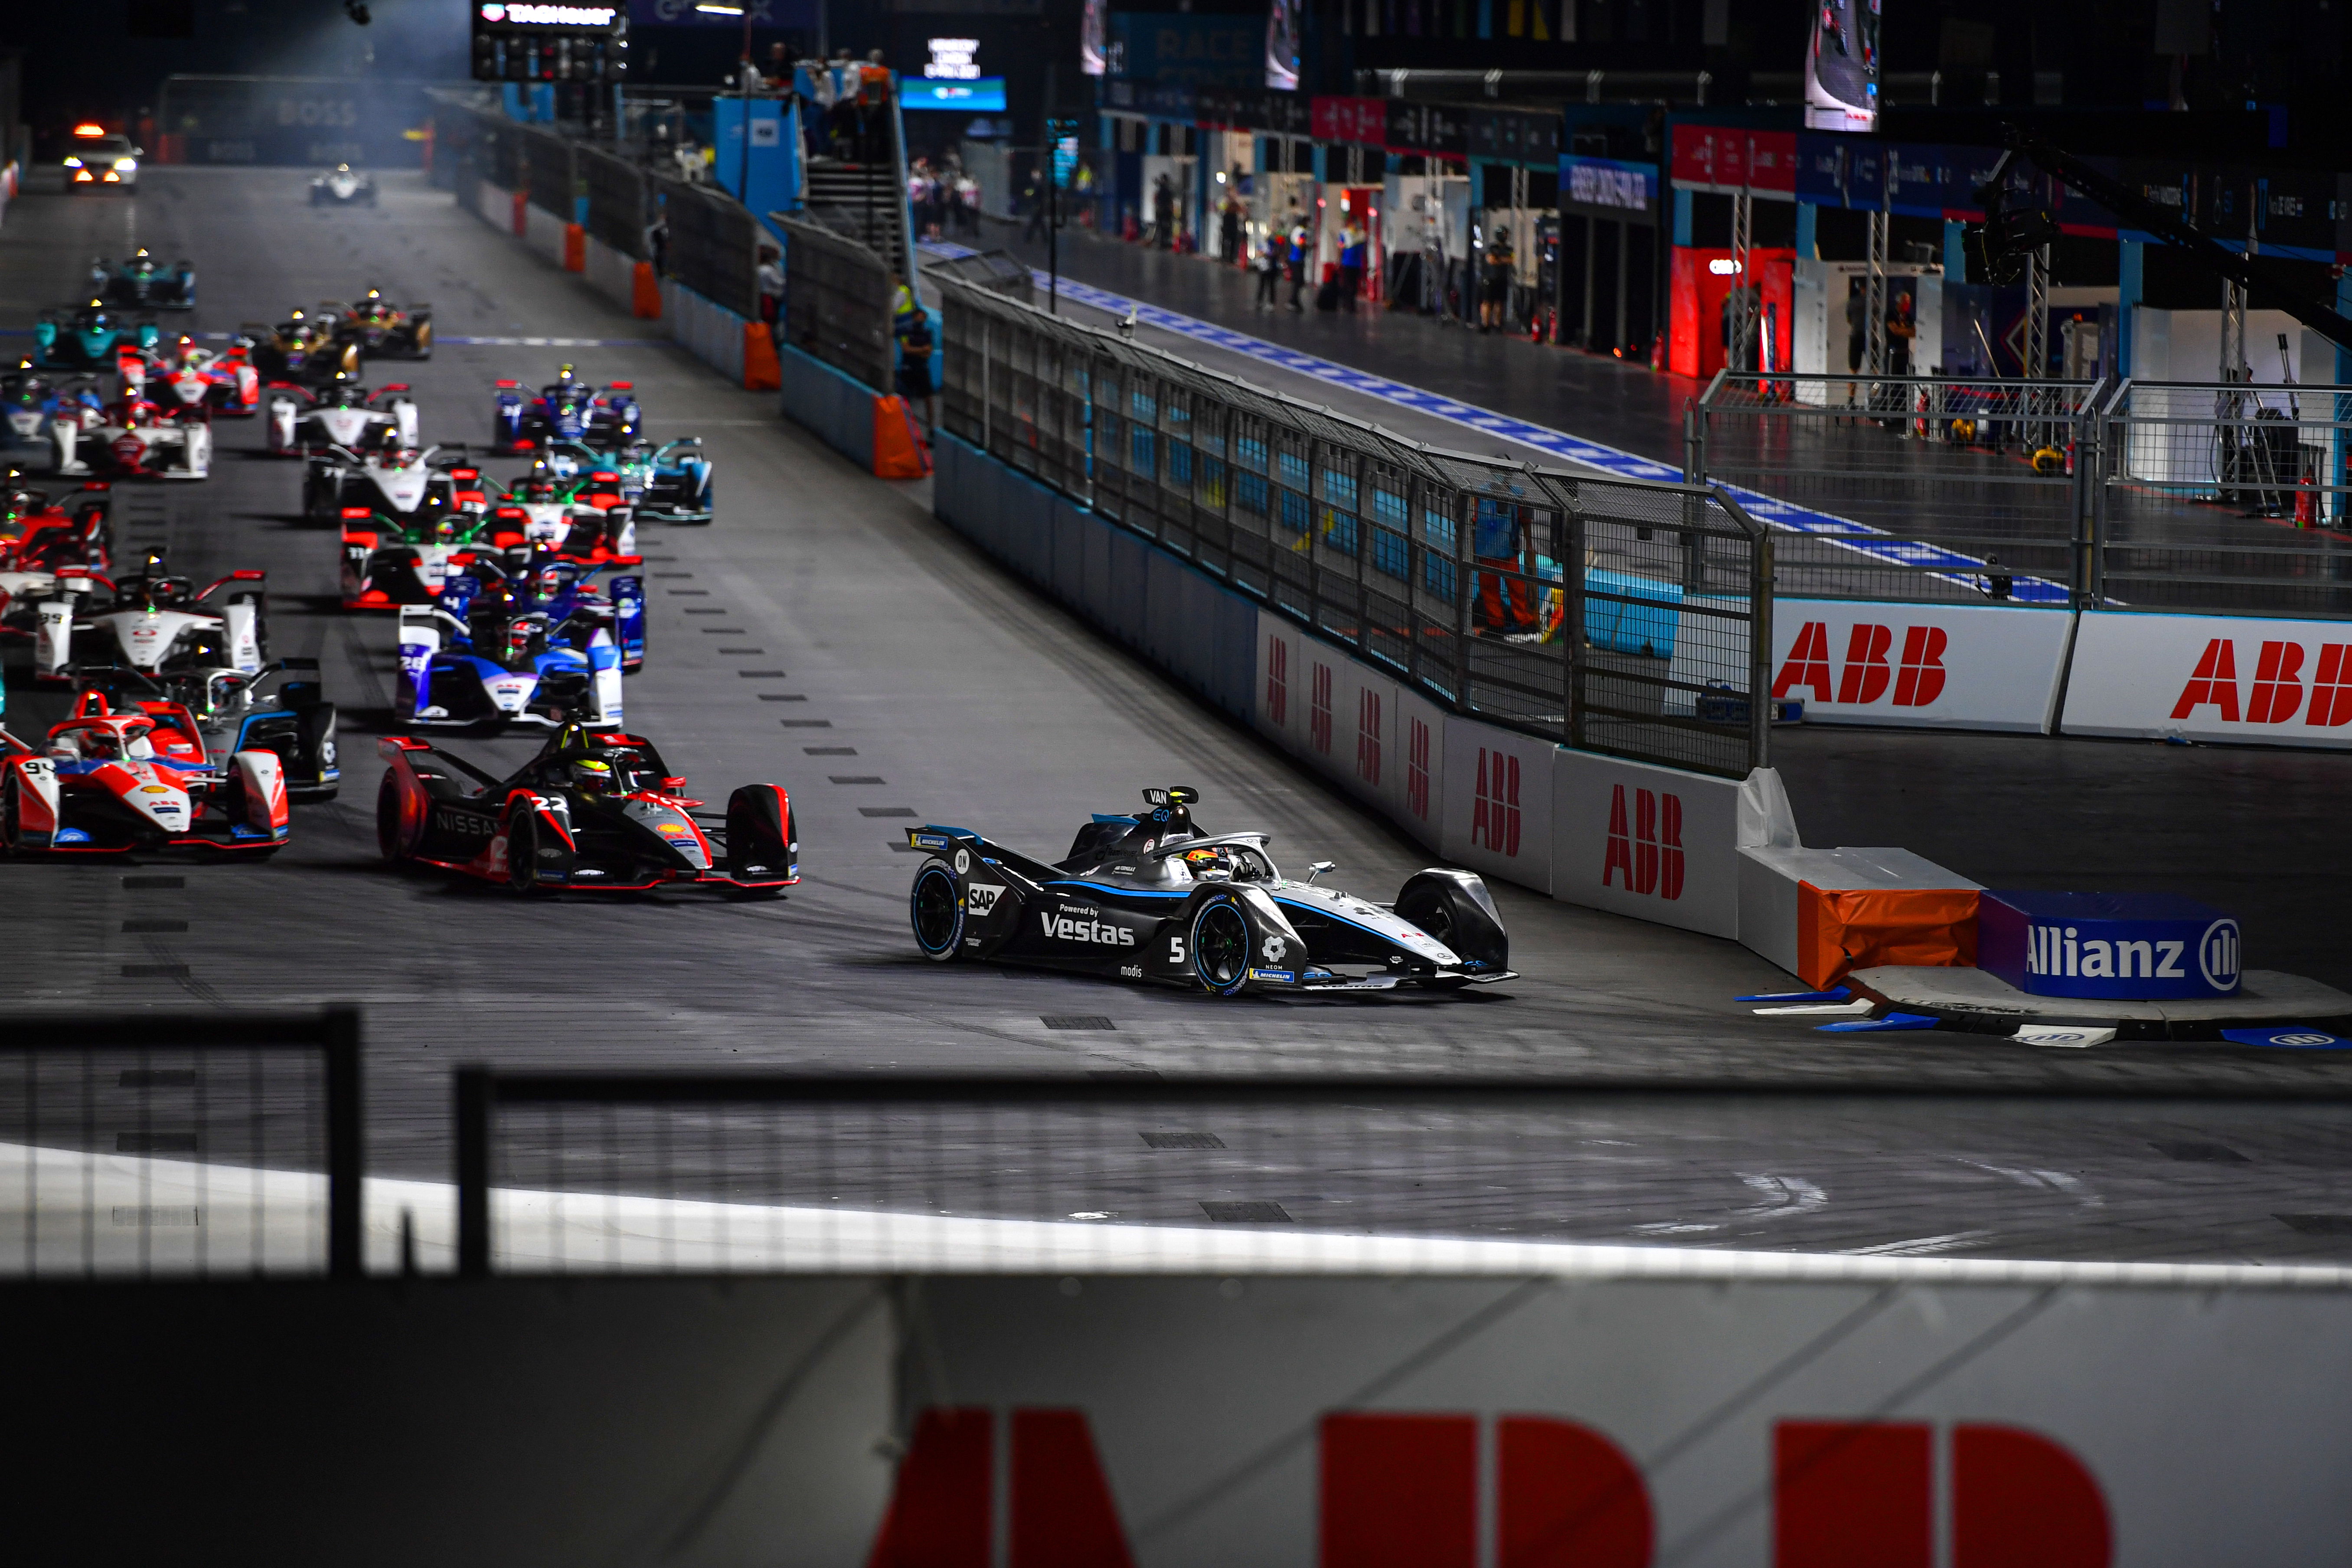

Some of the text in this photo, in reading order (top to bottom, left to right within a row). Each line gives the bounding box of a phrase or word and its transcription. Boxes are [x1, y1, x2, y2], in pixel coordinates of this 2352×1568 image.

[1156, 29, 1251, 59] RACE
[1771, 622, 1947, 706] ABB
[2169, 639, 2352, 726] ABB
[1311, 662, 1332, 755] ABB
[1358, 686, 1380, 786] ABB
[1407, 716, 1429, 821] ABB
[531, 796, 569, 814] 22
[1150, 790, 1167, 804] VAN
[1472, 748, 1521, 857] ABB
[1153, 809, 1169, 822] EQ
[1603, 784, 1685, 900] ABB
[958, 856, 967, 868] ON
[970, 889, 995, 910] SAP
[1059, 904, 1099, 918] Powered by
[1041, 911, 1134, 946] Vestas
[1169, 937, 1185, 963] 5
[2026, 924, 2185, 978] Allianz
[1121, 964, 1142, 978] modis
